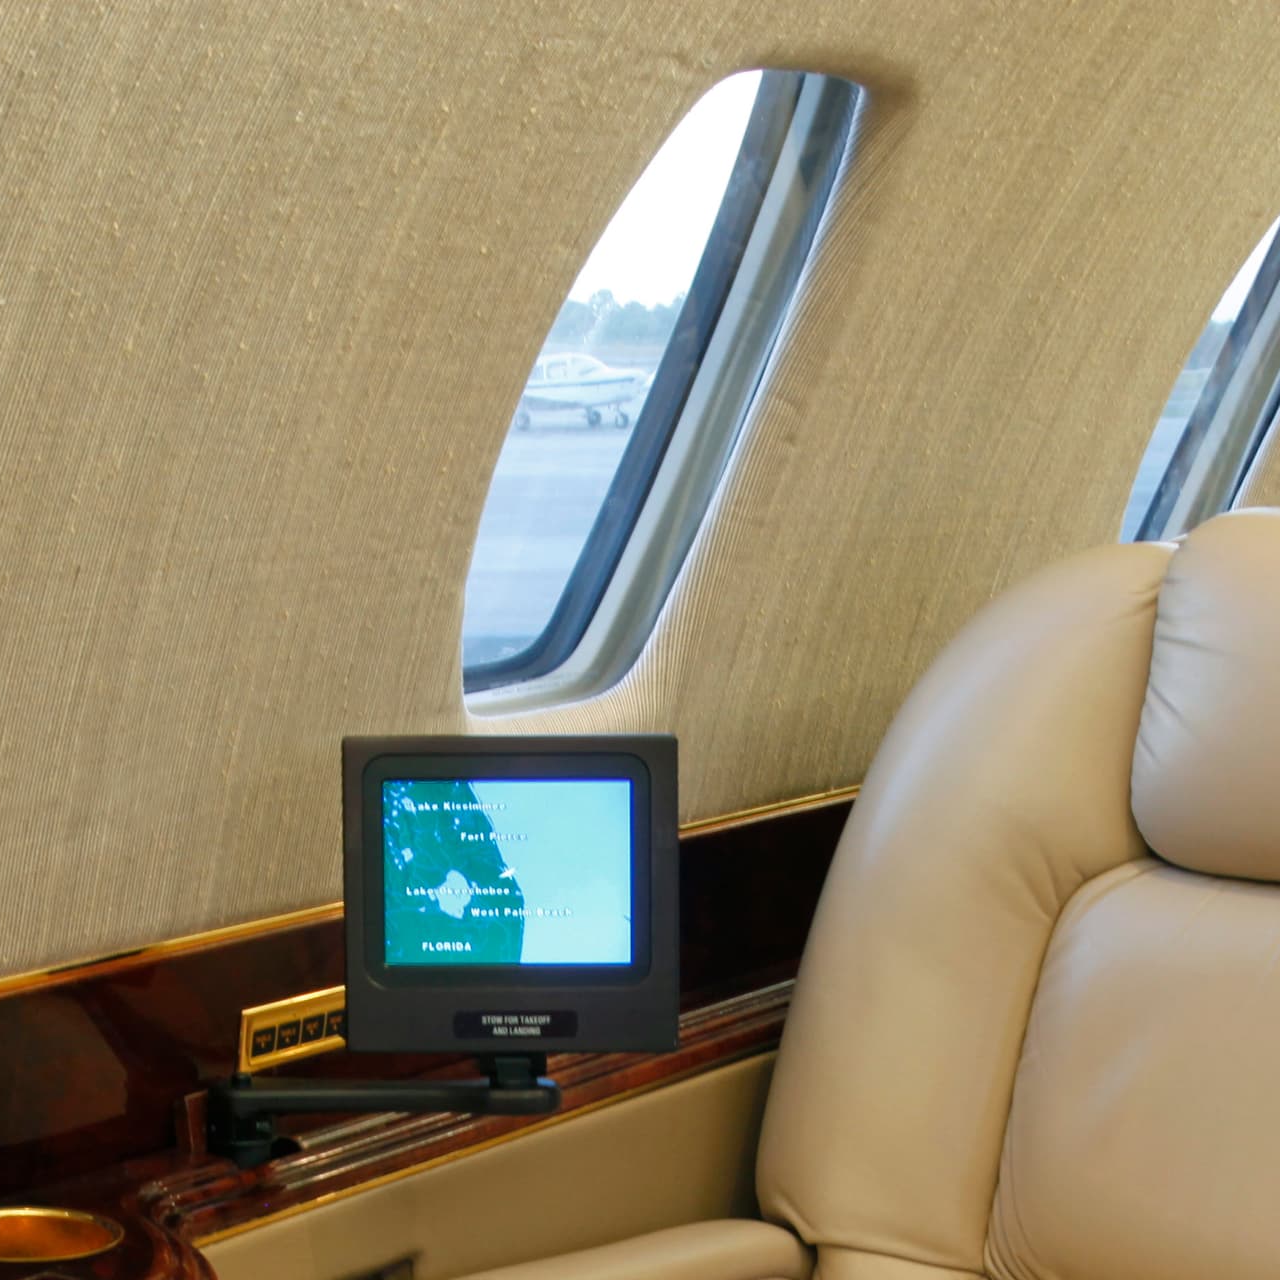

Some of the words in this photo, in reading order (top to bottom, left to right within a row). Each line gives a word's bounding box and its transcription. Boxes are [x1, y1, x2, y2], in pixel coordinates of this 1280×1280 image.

[460, 831, 485, 842] Fort
[405, 885, 434, 896] Lake
[471, 907, 500, 918] West
[504, 907, 532, 918] Palm
[421, 941, 472, 952] FLORIDA
[481, 1015, 503, 1025] STOW
[504, 1015, 519, 1025] FOR
[520, 1015, 552, 1025] TAKEOFF
[492, 1026, 508, 1036] AND
[509, 1026, 541, 1036] LANDING
